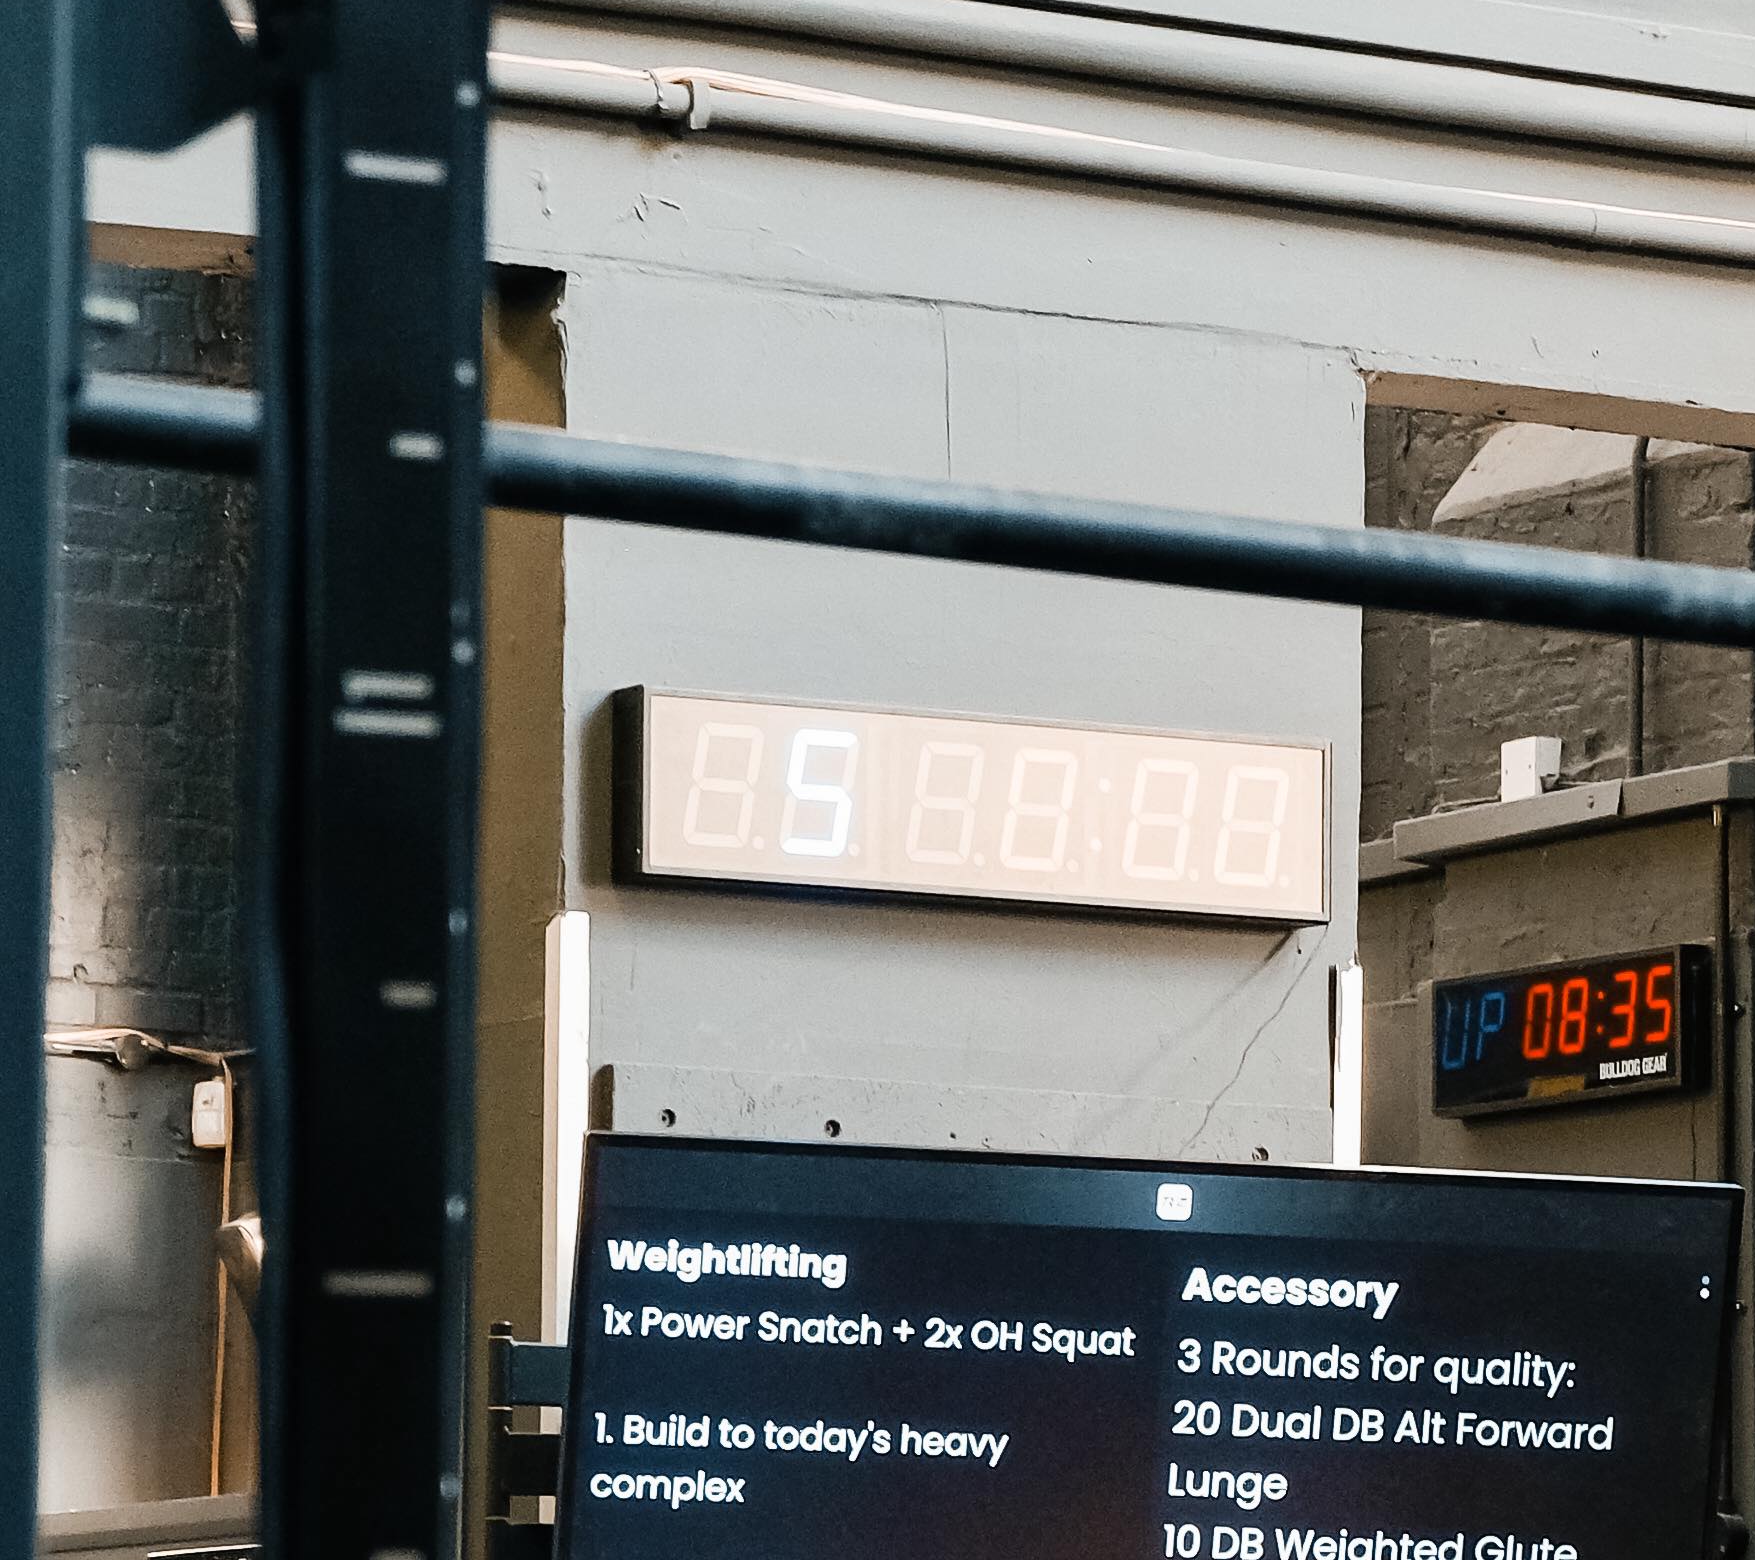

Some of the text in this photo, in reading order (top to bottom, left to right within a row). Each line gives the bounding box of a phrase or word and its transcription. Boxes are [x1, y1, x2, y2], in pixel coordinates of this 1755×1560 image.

[1441, 964, 1673, 1069] UP 08:35
[1600, 1053, 1667, 1080] BULLDOG GEAR
[608, 1239, 847, 1288] Weightlifting
[1182, 1268, 1399, 1319] Accessory
[603, 1304, 1136, 1362] 1x Power Snatch + 2x OH Squat
[1178, 1338, 1575, 1398] 3 Rounds for quality:
[595, 1412, 1009, 1467] 1. Build to today's heavy
[1172, 1400, 1613, 1450] 20 Dual DB Alt Forward
[590, 1470, 745, 1509] complex
[1168, 1463, 1288, 1510] Lunge
[1164, 1524, 1200, 1558] 10
[1212, 1526, 1264, 1560] DB
